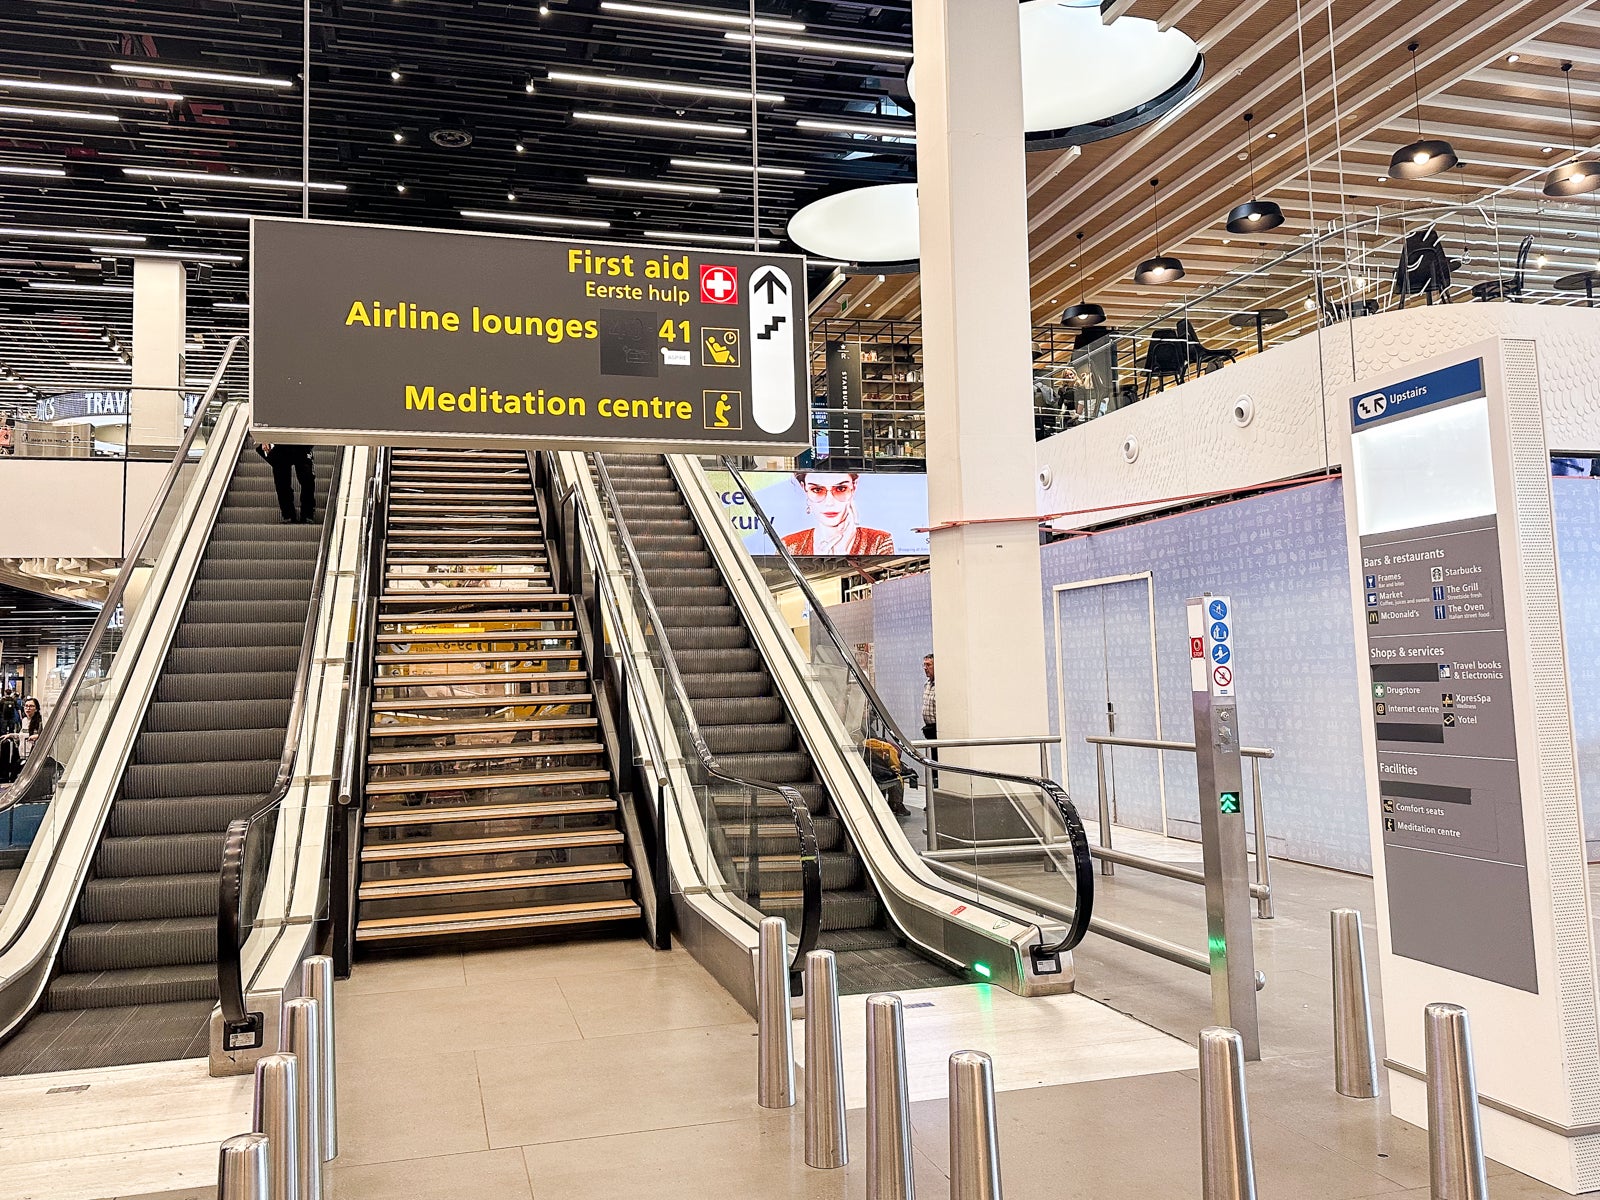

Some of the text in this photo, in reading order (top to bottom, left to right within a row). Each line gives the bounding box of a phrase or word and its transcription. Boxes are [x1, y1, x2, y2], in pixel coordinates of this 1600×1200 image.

[567, 249, 690, 281] First aid
[585, 281, 690, 306] Eerste hulp
[345, 300, 460, 332] Airline
[471, 306, 598, 343] lounges
[658, 319, 691, 343] 41
[1389, 386, 1428, 405] Upstairs
[84, 391, 132, 415] TRAV
[404, 386, 693, 420] Meditation centre
[716, 491, 745, 505] ce
[1363, 549, 1445, 568] Bars & restaurants
[1378, 573, 1402, 582] Frames
[1445, 565, 1482, 577] Starbucks
[1446, 583, 1479, 593] The Grill
[1379, 591, 1404, 600] Market
[1448, 603, 1484, 612] The Oven
[1381, 610, 1420, 620] McDonald's
[1371, 645, 1445, 660] Shops & services
[1453, 660, 1502, 670] Travel books
[1454, 670, 1504, 680] & Electronics
[1386, 686, 1421, 696] Drugstore
[1456, 694, 1491, 704] XpresSpa
[1388, 704, 1440, 714] Internet centre
[1458, 715, 1478, 724] Yotel
[1380, 763, 1418, 776] Facilities
[1396, 803, 1445, 816] Comfort seats
[1397, 821, 1461, 838] Meditation centre
